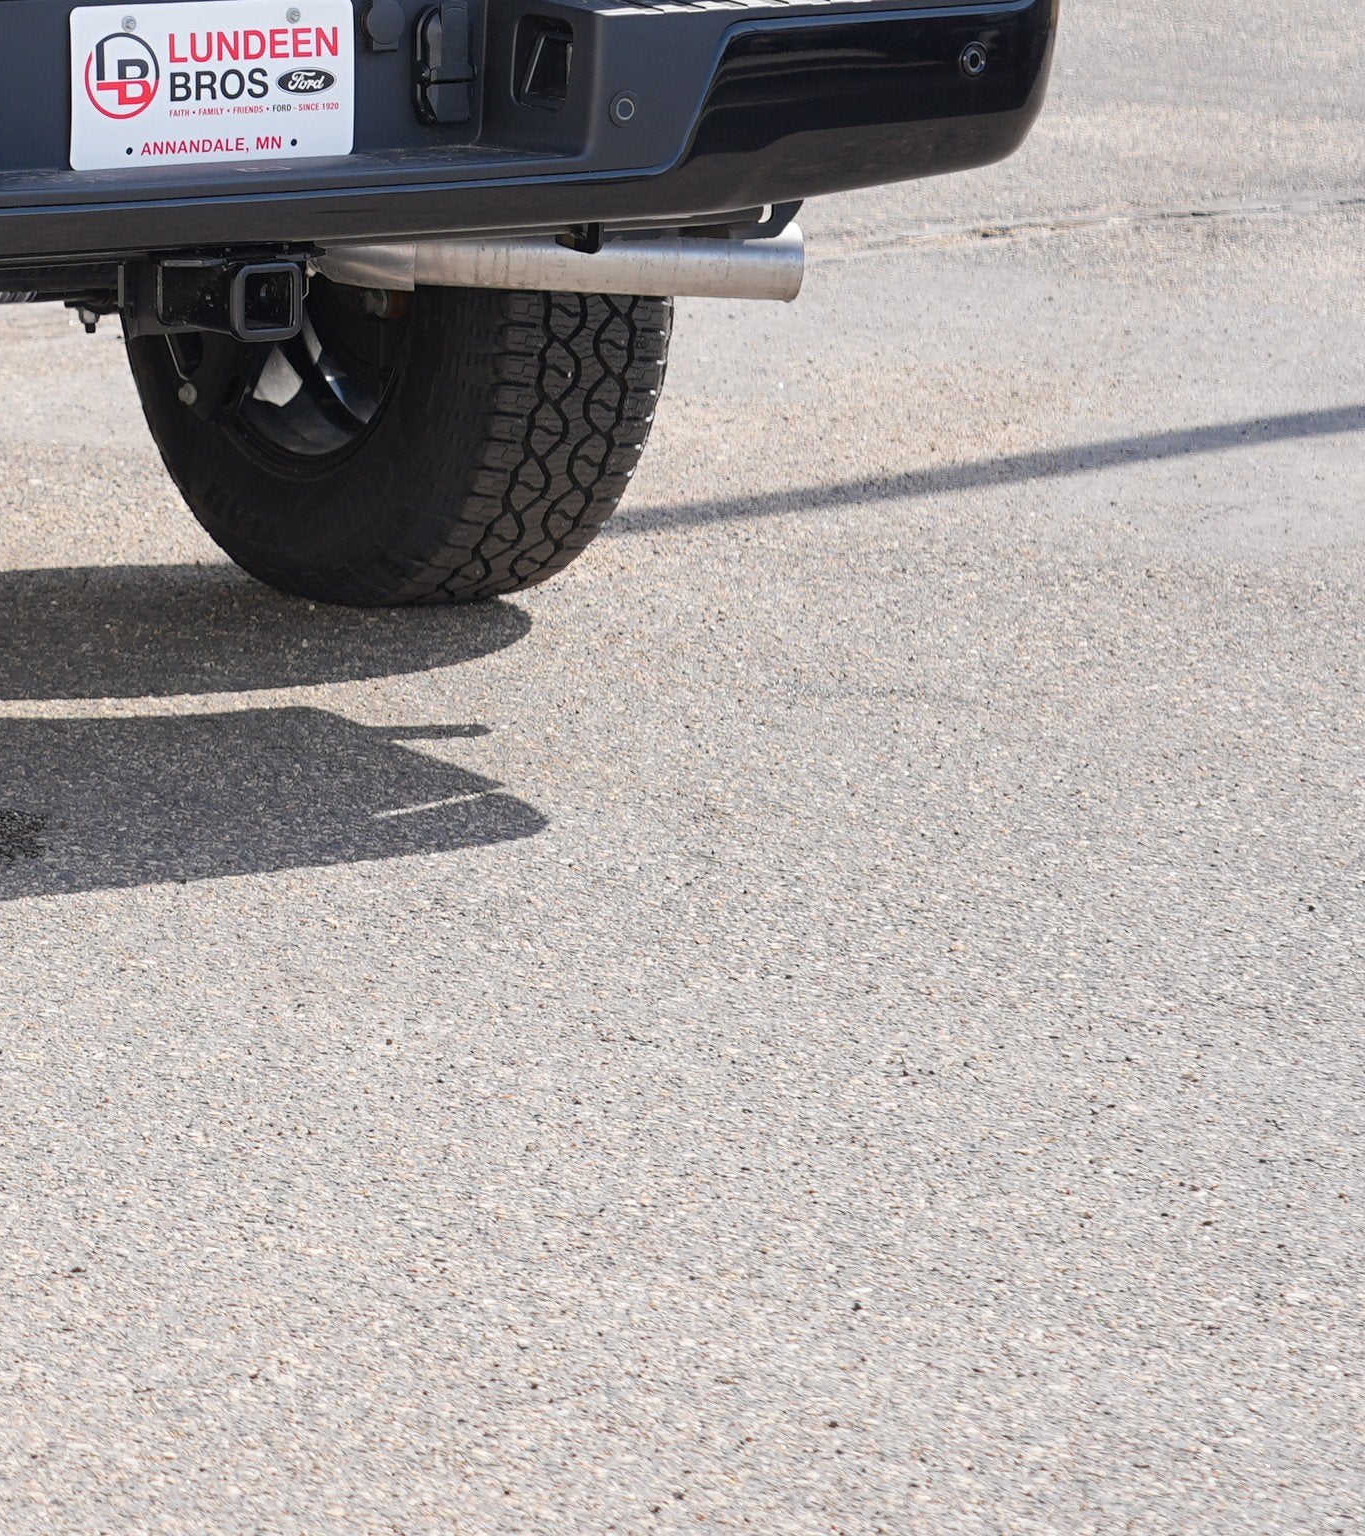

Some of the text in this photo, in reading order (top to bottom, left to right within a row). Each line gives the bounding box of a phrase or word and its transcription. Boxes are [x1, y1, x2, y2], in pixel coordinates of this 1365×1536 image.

[168, 26, 339, 63] LUNDEEN
[170, 68, 325, 102] BROS Ford
[169, 101, 340, 118] FAITH FAMILY FRIENDS FORD SINCE 1920
[141, 135, 282, 156] ANNANDALE, MN
